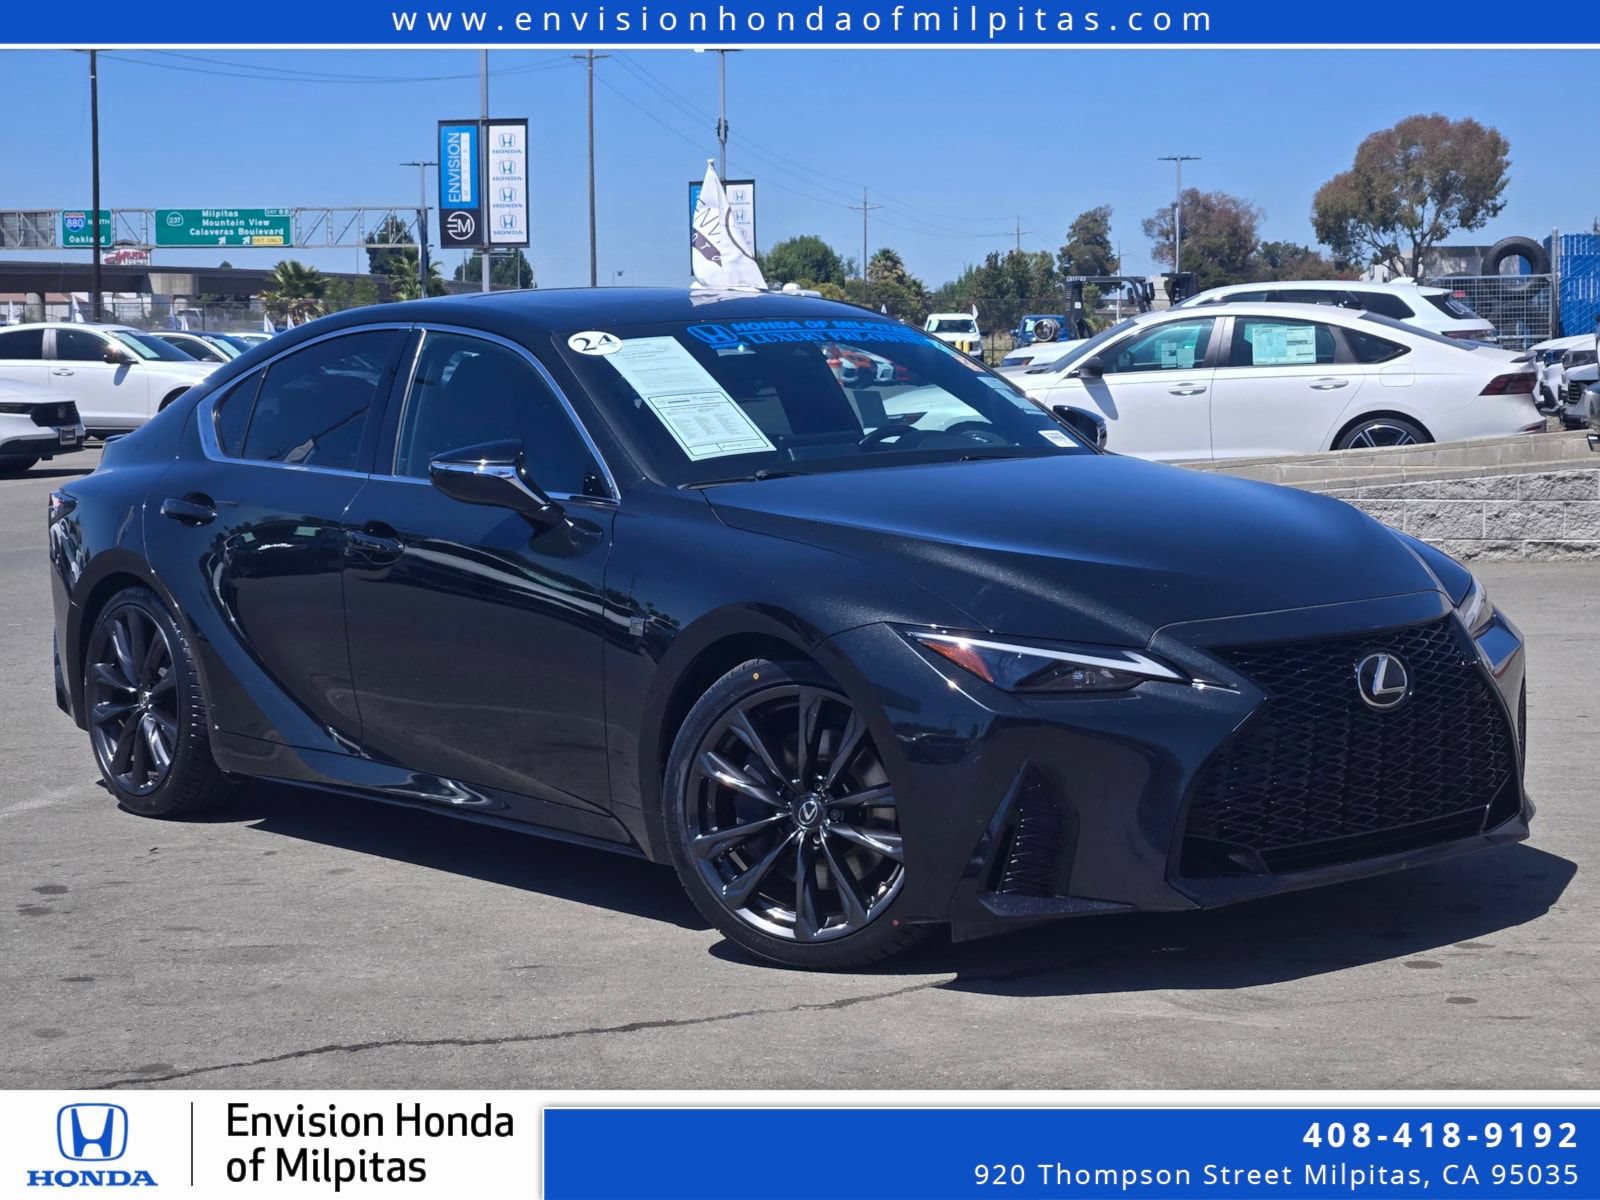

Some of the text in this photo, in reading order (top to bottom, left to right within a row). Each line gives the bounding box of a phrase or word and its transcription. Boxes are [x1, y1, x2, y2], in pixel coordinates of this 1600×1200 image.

[448, 132, 460, 203] ENVISION
[202, 210, 239, 218] Milpitas
[67, 218, 84, 228] 880
[189, 228, 284, 236] Calaveras Boulevard
[69, 235, 106, 244] Oaklad
[731, 321, 803, 332] HONDA
[804, 320, 828, 329] OF
[573, 334, 618, 352] 24
[746, 331, 827, 344] LUXURY
